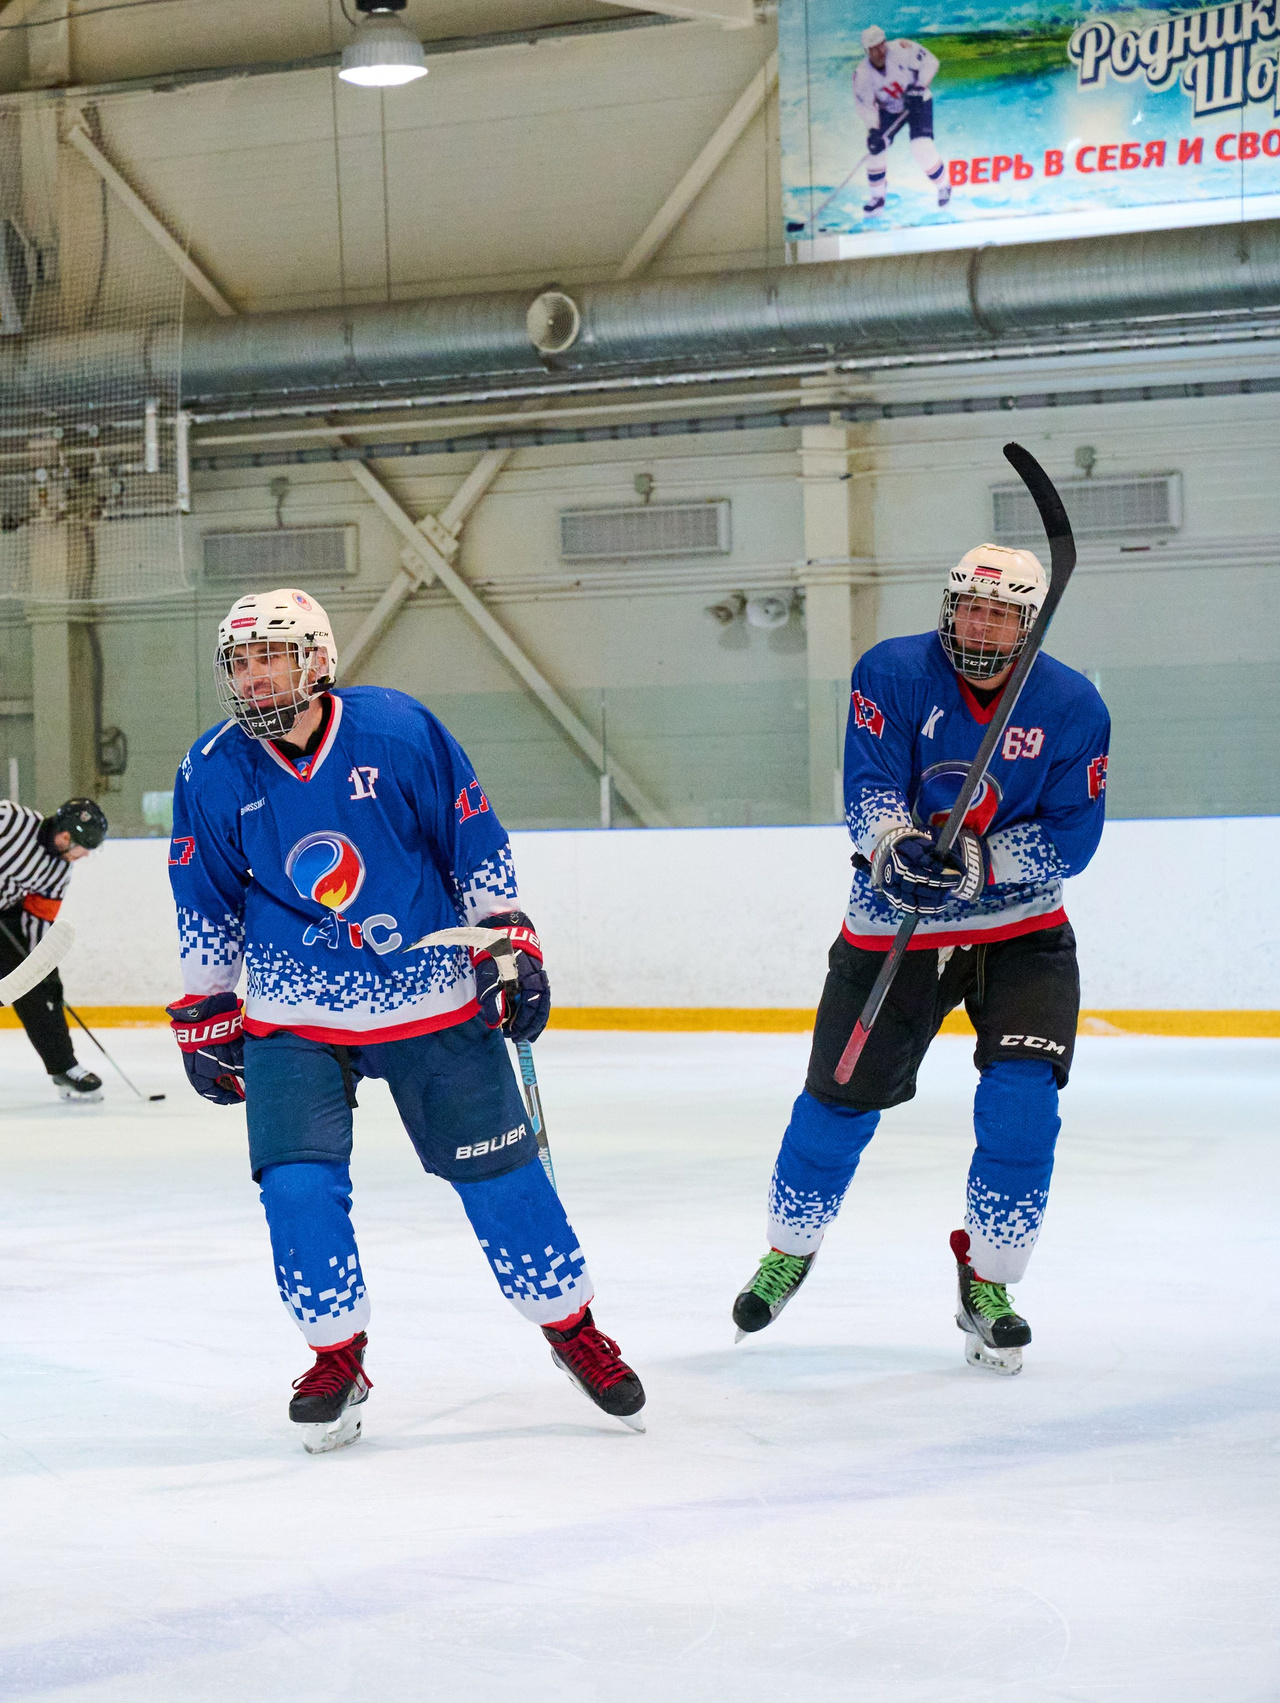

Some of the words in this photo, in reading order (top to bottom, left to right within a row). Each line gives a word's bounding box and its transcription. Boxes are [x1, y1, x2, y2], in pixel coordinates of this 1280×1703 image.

[1070, 0, 1280, 86] Родник
[1182, 46, 1280, 120] Шо
[948, 154, 1034, 187] ВЕРЬ
[1043, 149, 1065, 177] В
[1075, 140, 1166, 174] СЕБЯ
[1177, 136, 1204, 166] И
[970, 577, 1001, 586] CCM
[251, 718, 277, 728] CCM
[1002, 727, 1045, 761] 69
[348, 766, 379, 800] 17
[959, 836, 980, 900] WARR
[999, 1034, 1067, 1056] CCM
[455, 1123, 527, 1160] BAUER
